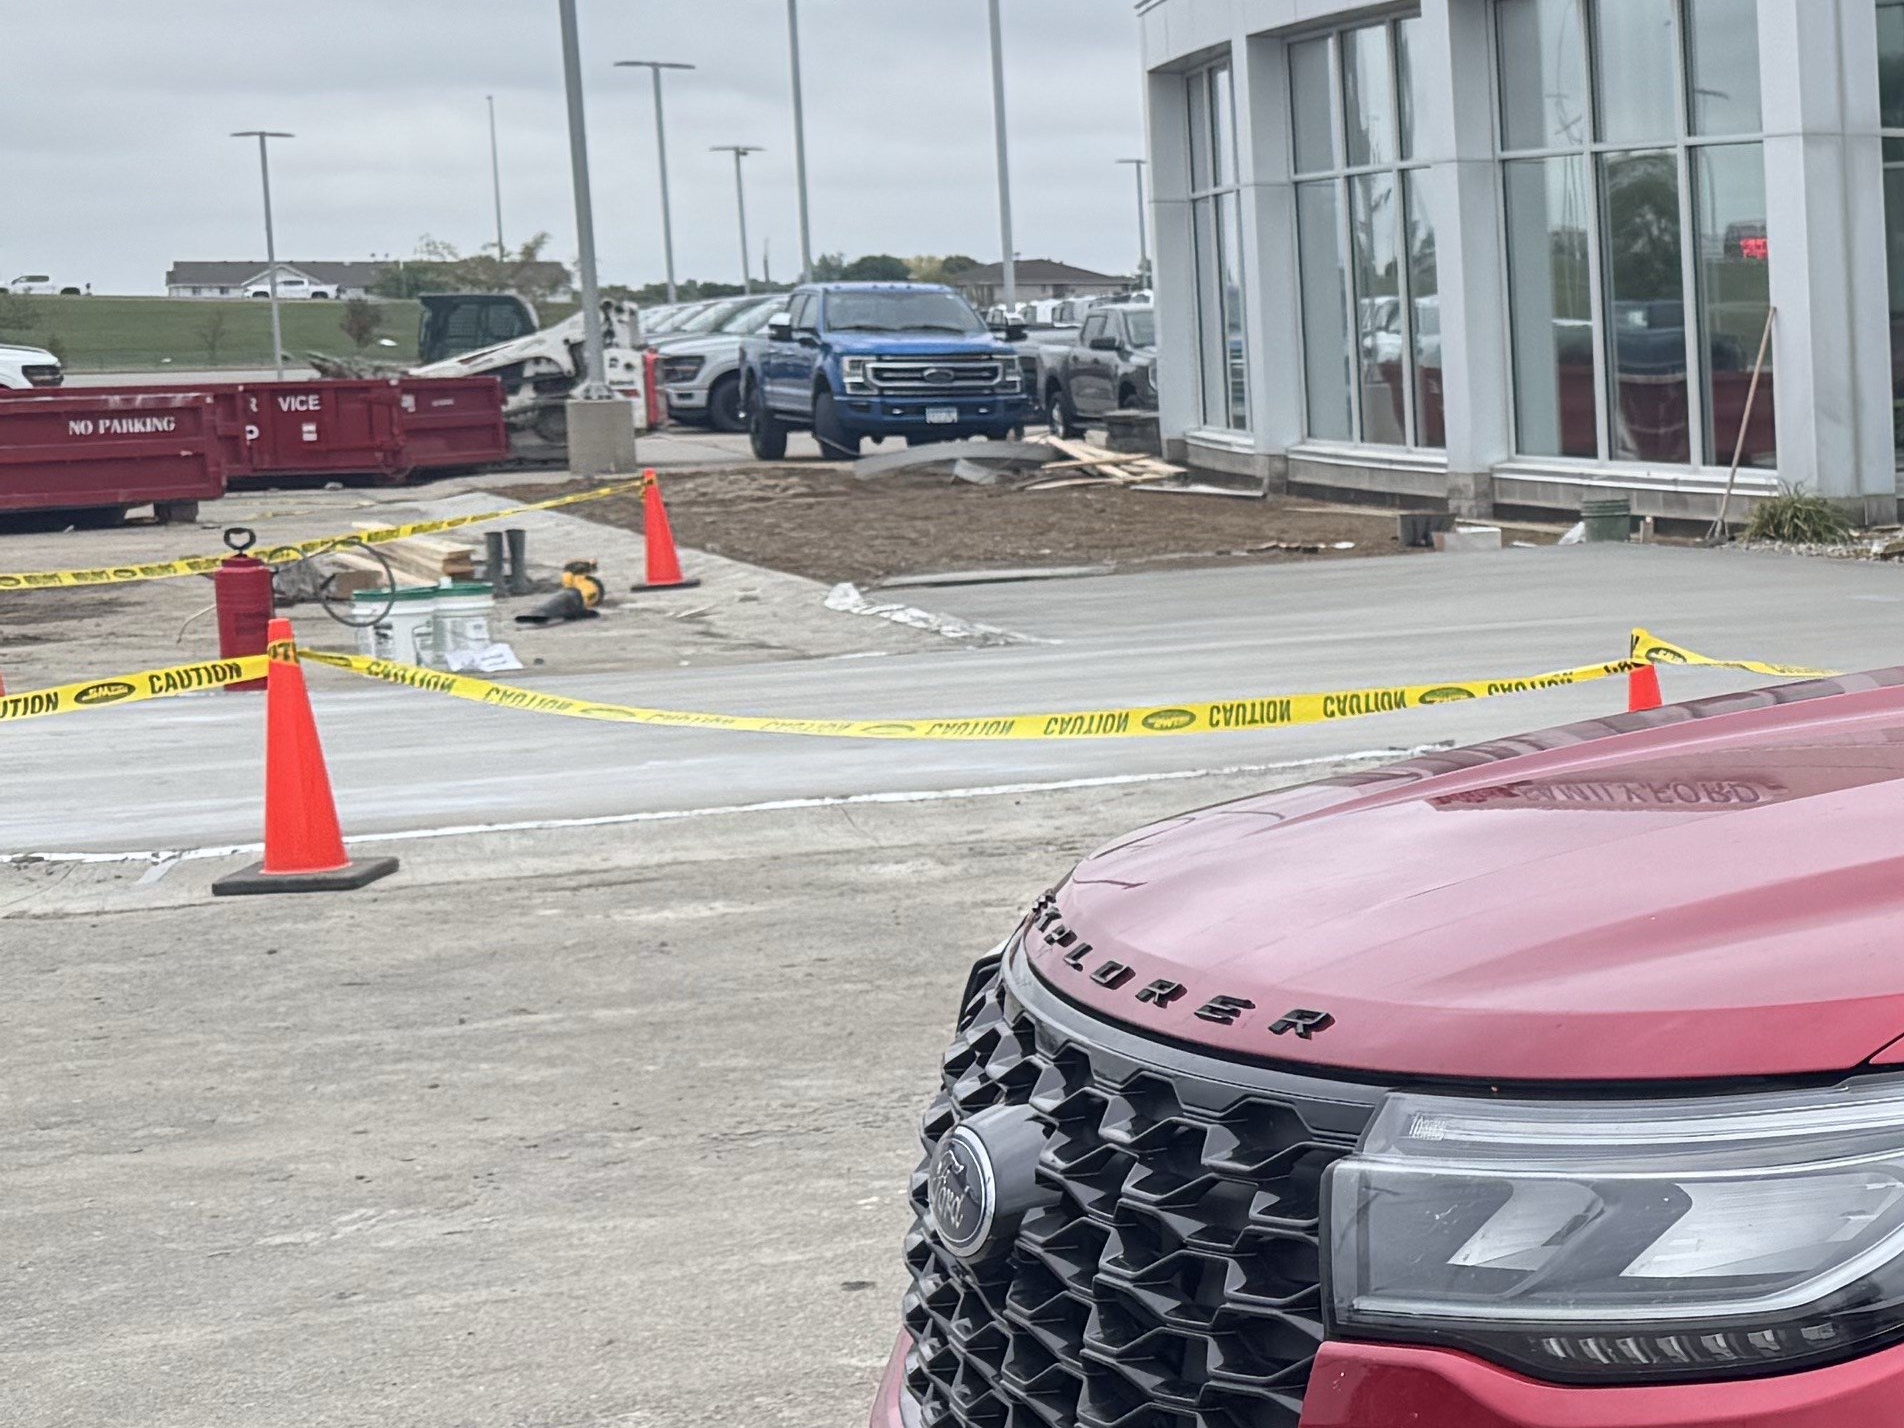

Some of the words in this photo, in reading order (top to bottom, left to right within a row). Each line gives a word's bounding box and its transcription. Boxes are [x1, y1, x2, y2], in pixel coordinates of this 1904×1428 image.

[69, 420, 93, 435] NO
[99, 416, 176, 434] PARKING
[0, 691, 59, 718] UTION
[148, 662, 242, 694] CAUTION
